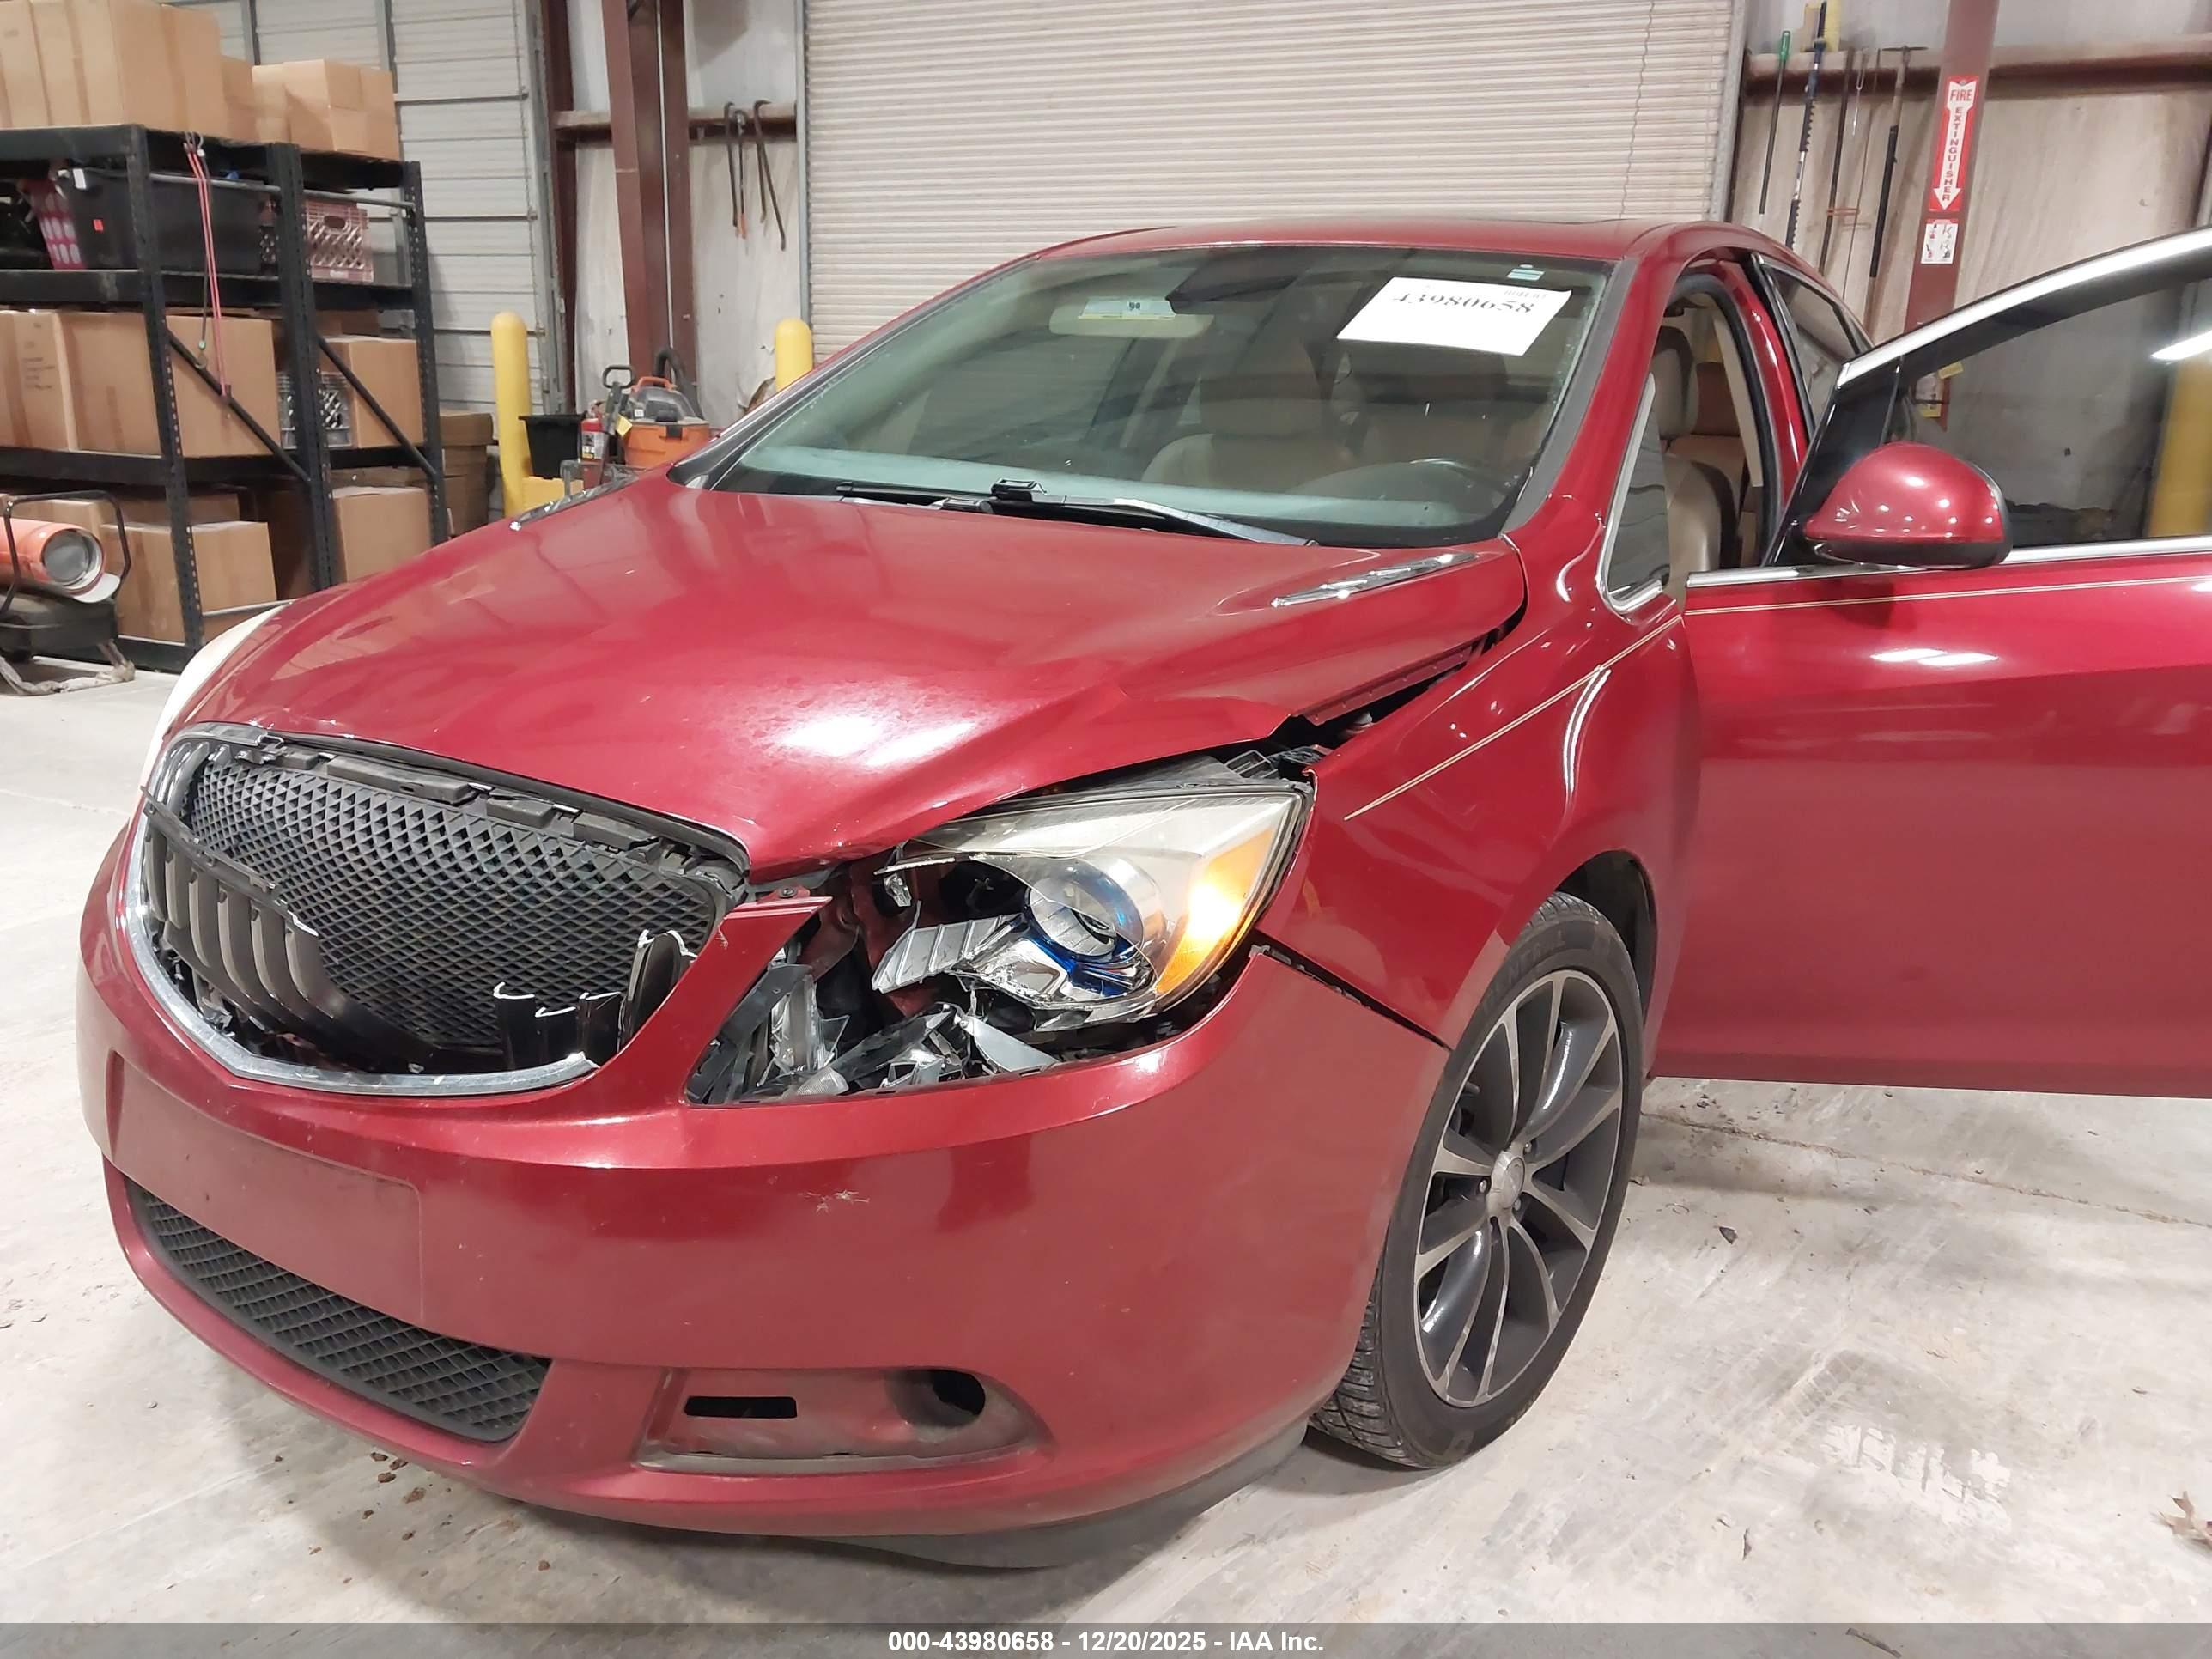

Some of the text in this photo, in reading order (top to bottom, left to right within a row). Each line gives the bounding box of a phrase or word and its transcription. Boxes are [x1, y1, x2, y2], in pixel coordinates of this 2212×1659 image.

[1949, 88, 1973, 101] FIRE
[1942, 106, 1964, 202] EXTINGUISHER
[1393, 293, 1536, 313] 43980658
